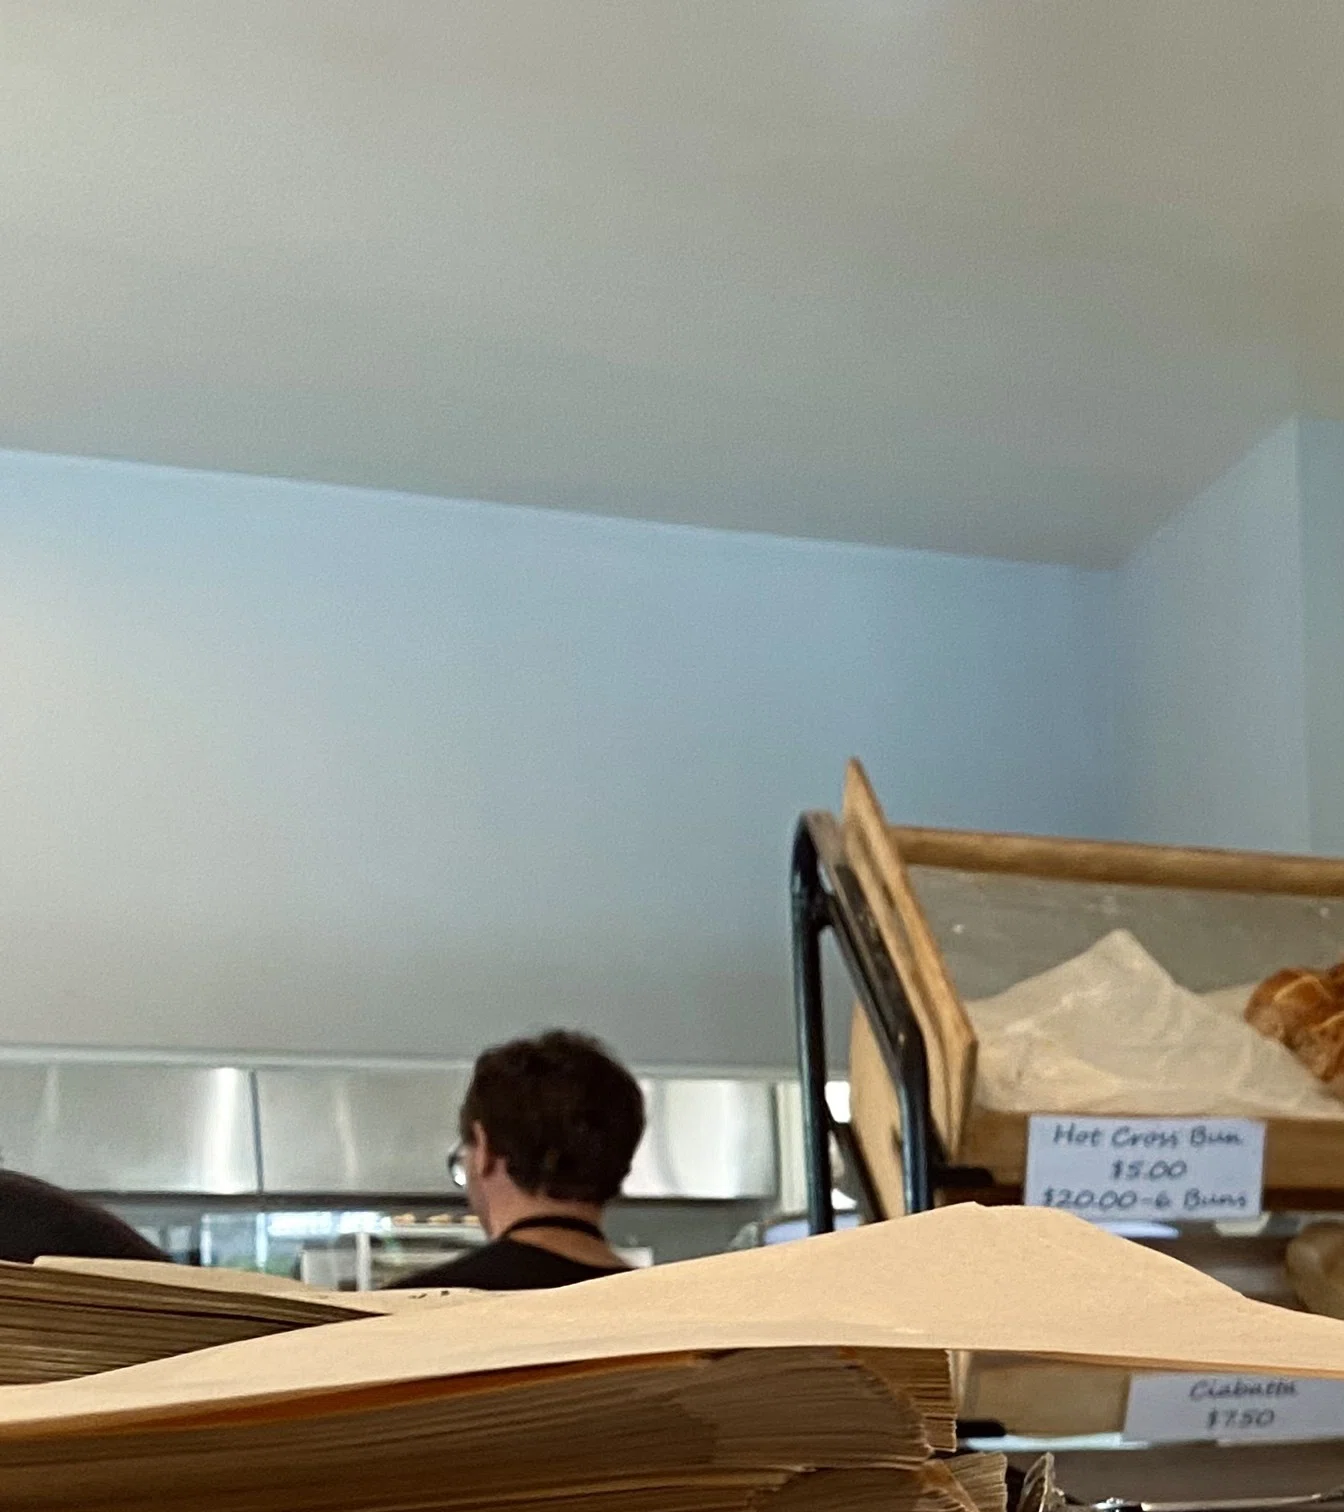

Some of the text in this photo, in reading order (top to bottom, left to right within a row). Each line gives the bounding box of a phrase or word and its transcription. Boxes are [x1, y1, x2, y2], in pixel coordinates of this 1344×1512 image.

[1053, 1122, 1242, 1148] Hot Cross Bun
[1183, 1188, 1247, 1209] Buns
[1188, 1378, 1297, 1401] Ciabatta
